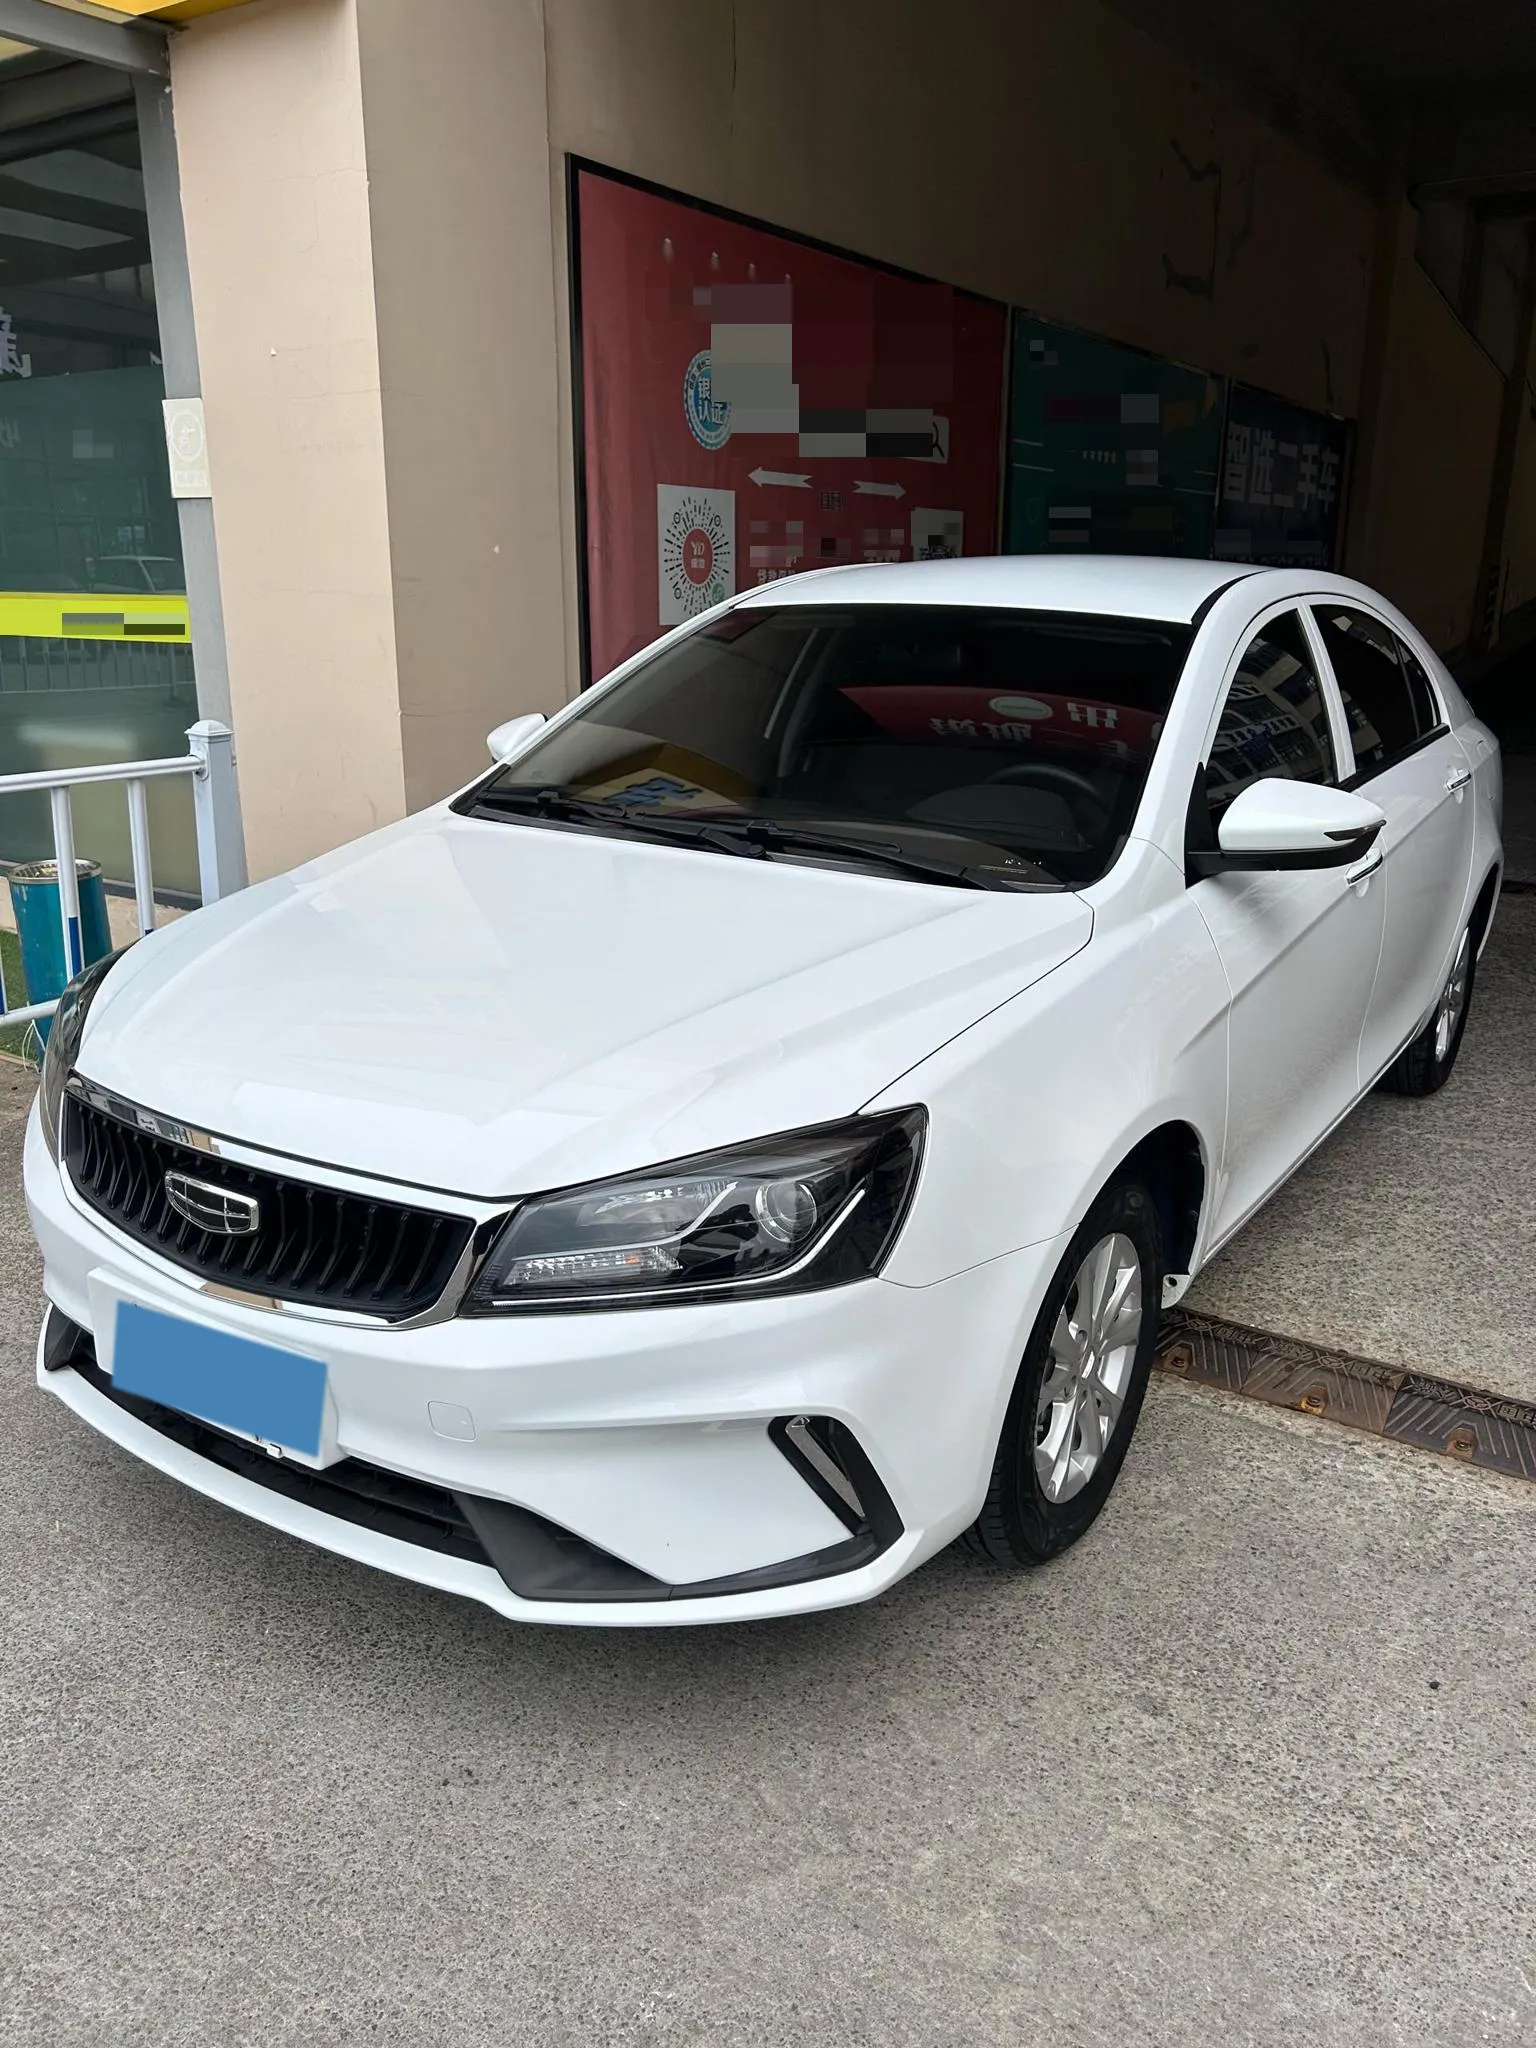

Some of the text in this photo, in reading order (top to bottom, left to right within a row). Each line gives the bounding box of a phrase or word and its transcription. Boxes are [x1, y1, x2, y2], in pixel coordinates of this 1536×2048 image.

[698, 400, 725, 424] 认证
[1223, 421, 1339, 513] 智选二手车
